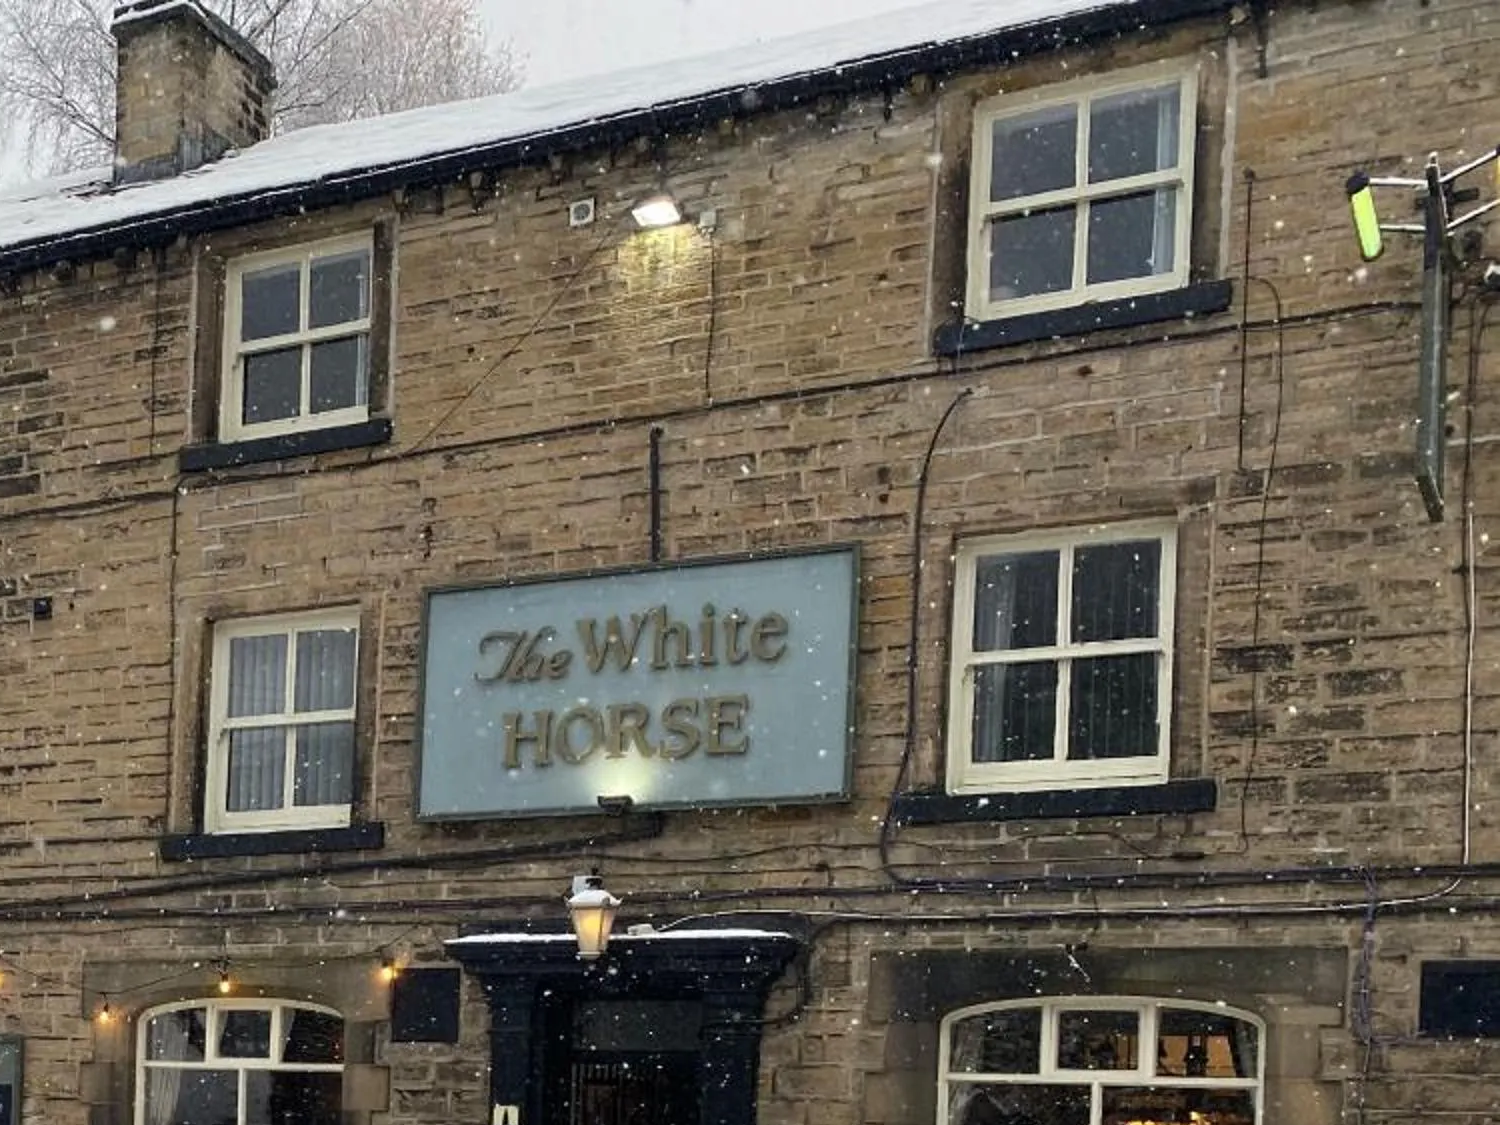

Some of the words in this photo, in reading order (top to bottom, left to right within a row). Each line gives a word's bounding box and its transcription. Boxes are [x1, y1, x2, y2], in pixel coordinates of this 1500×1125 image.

[474, 625, 573, 684] The
[576, 602, 791, 675] White
[503, 694, 751, 769] HORSE
